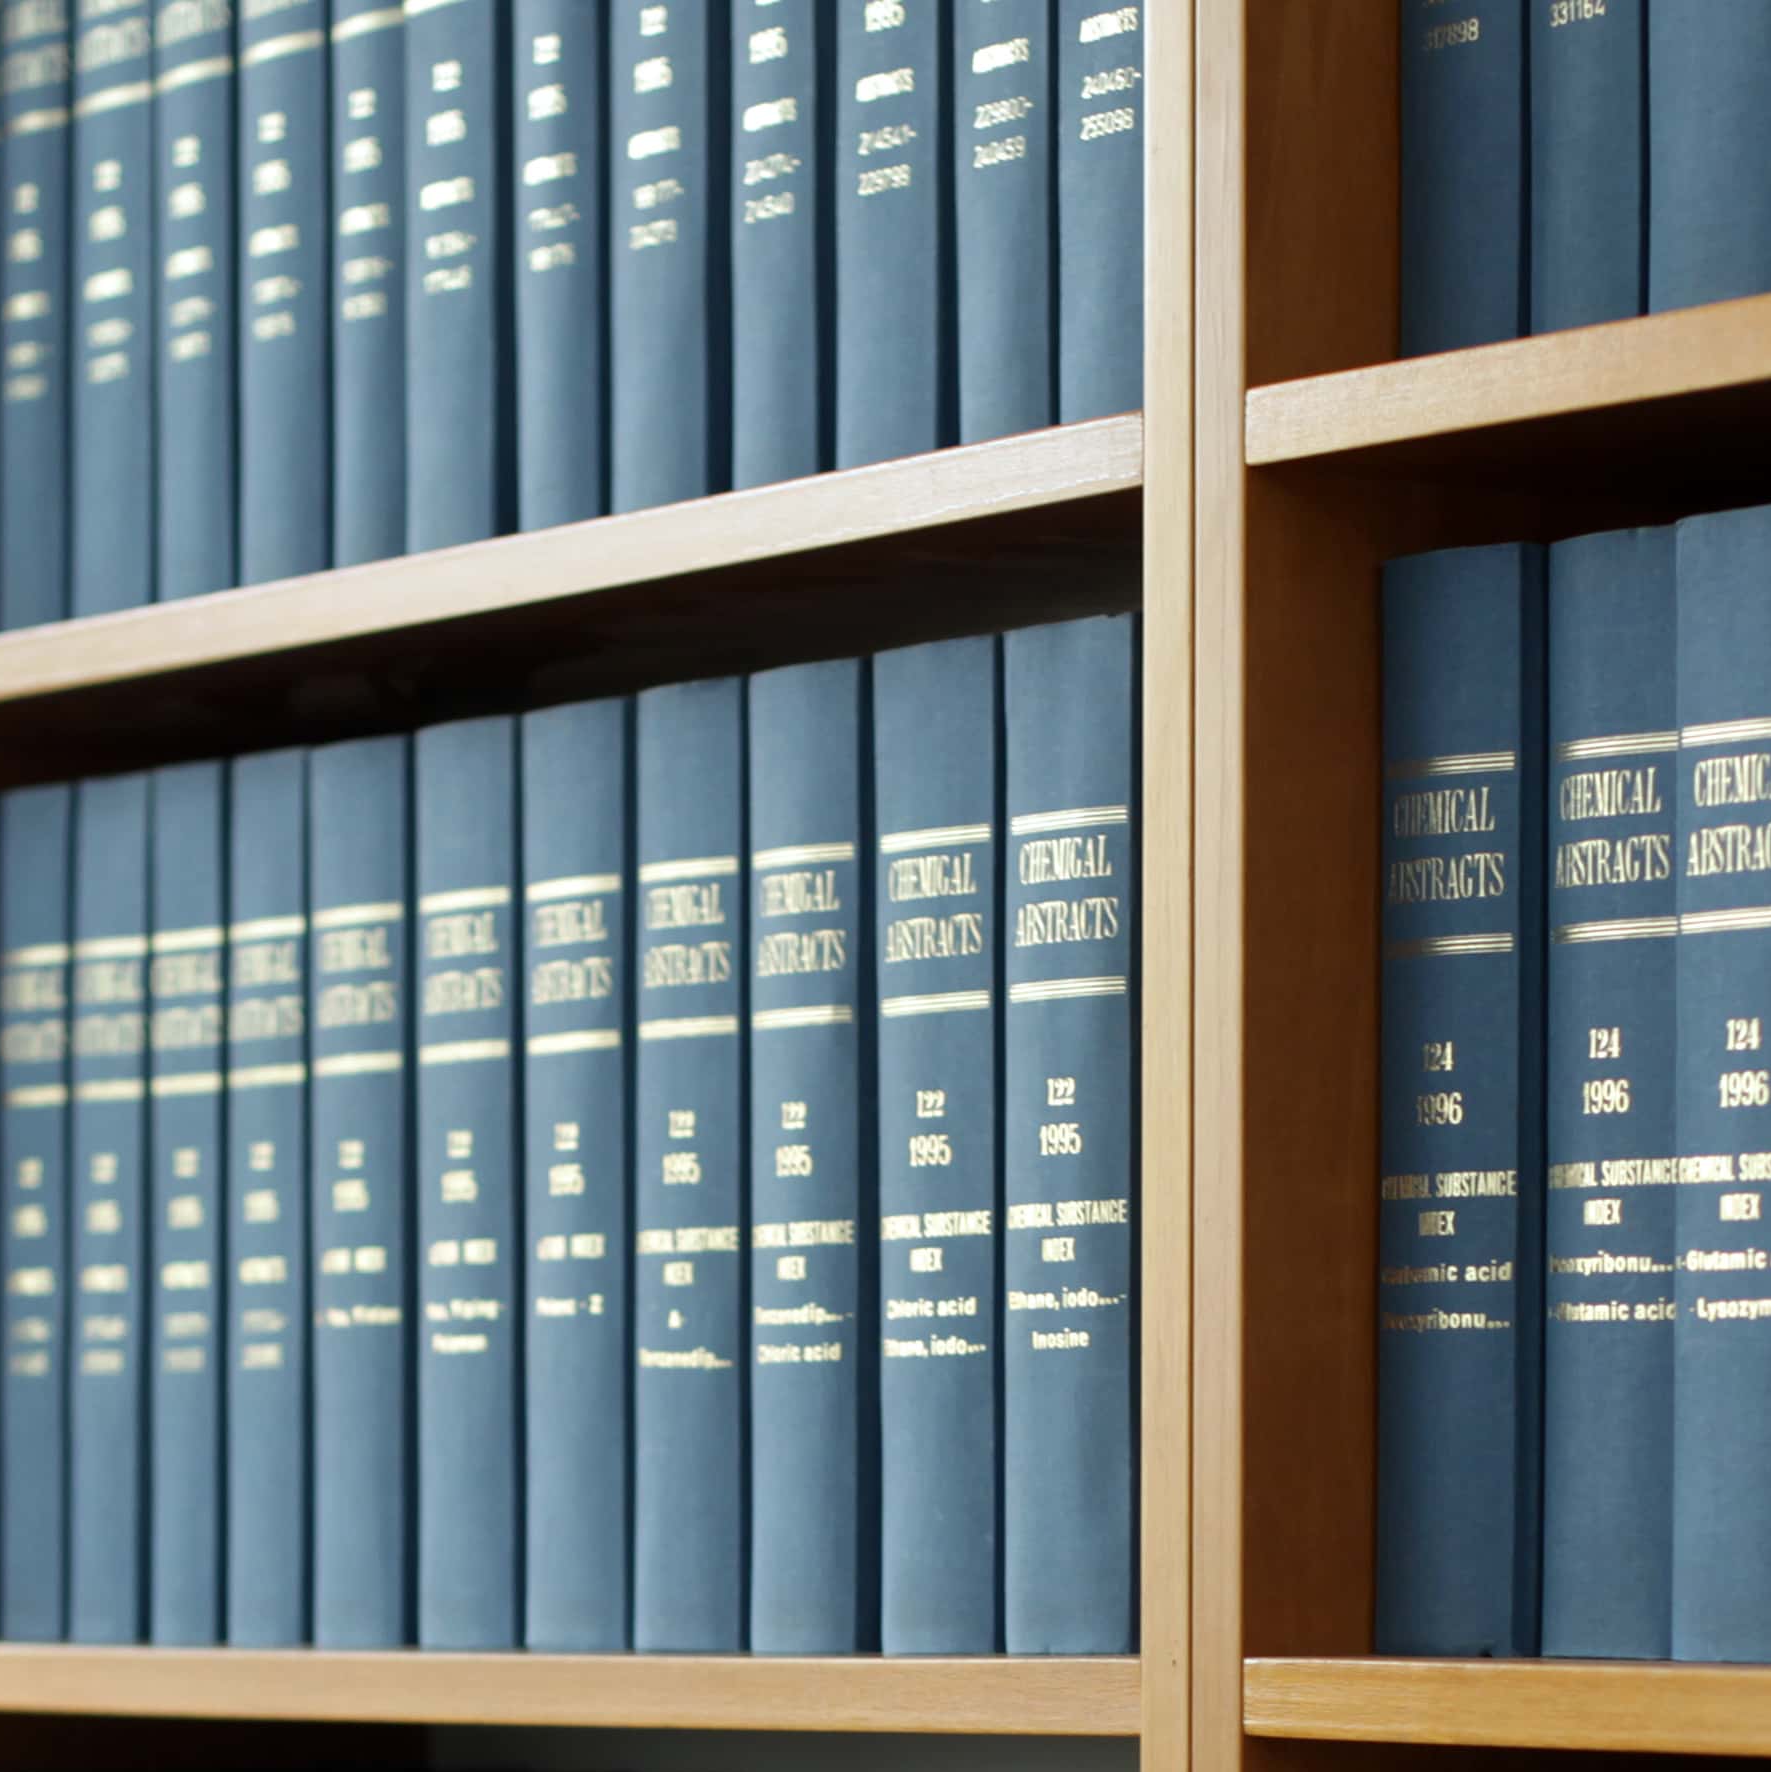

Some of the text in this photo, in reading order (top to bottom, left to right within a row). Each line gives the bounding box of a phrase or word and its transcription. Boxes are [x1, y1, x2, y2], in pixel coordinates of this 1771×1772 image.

[1561, 767, 1662, 820] CHEMICAL
[1394, 786, 1495, 837] CHEMICAL
[1019, 834, 1112, 886] CHEMICAL
[1555, 834, 1670, 888] ABSTRACTS
[1389, 852, 1505, 904] ABSTRACTS
[885, 913, 982, 961] ABSTRACTS
[1015, 897, 1119, 948] ABSTRACTS
[1588, 1027, 1621, 1058] 124
[1726, 1018, 1760, 1051] 124
[1423, 1041, 1454, 1071] 124
[1582, 1079, 1630, 1114] 1996
[1720, 1070, 1770, 1108] 1996
[1417, 1092, 1463, 1125] 1996
[908, 1133, 952, 1167] 1995
[1040, 1123, 1083, 1157] 1995
[1435, 1169, 1517, 1197] SUBSTANCE
[1601, 1158, 1677, 1187] SUBSTANCE
[1056, 1199, 1128, 1227] SUBSTANCE
[1464, 1260, 1513, 1282] acid
[937, 1296, 977, 1317] acid
[1633, 1297, 1676, 1321] acid
[1032, 1327, 1090, 1350] Inosine
